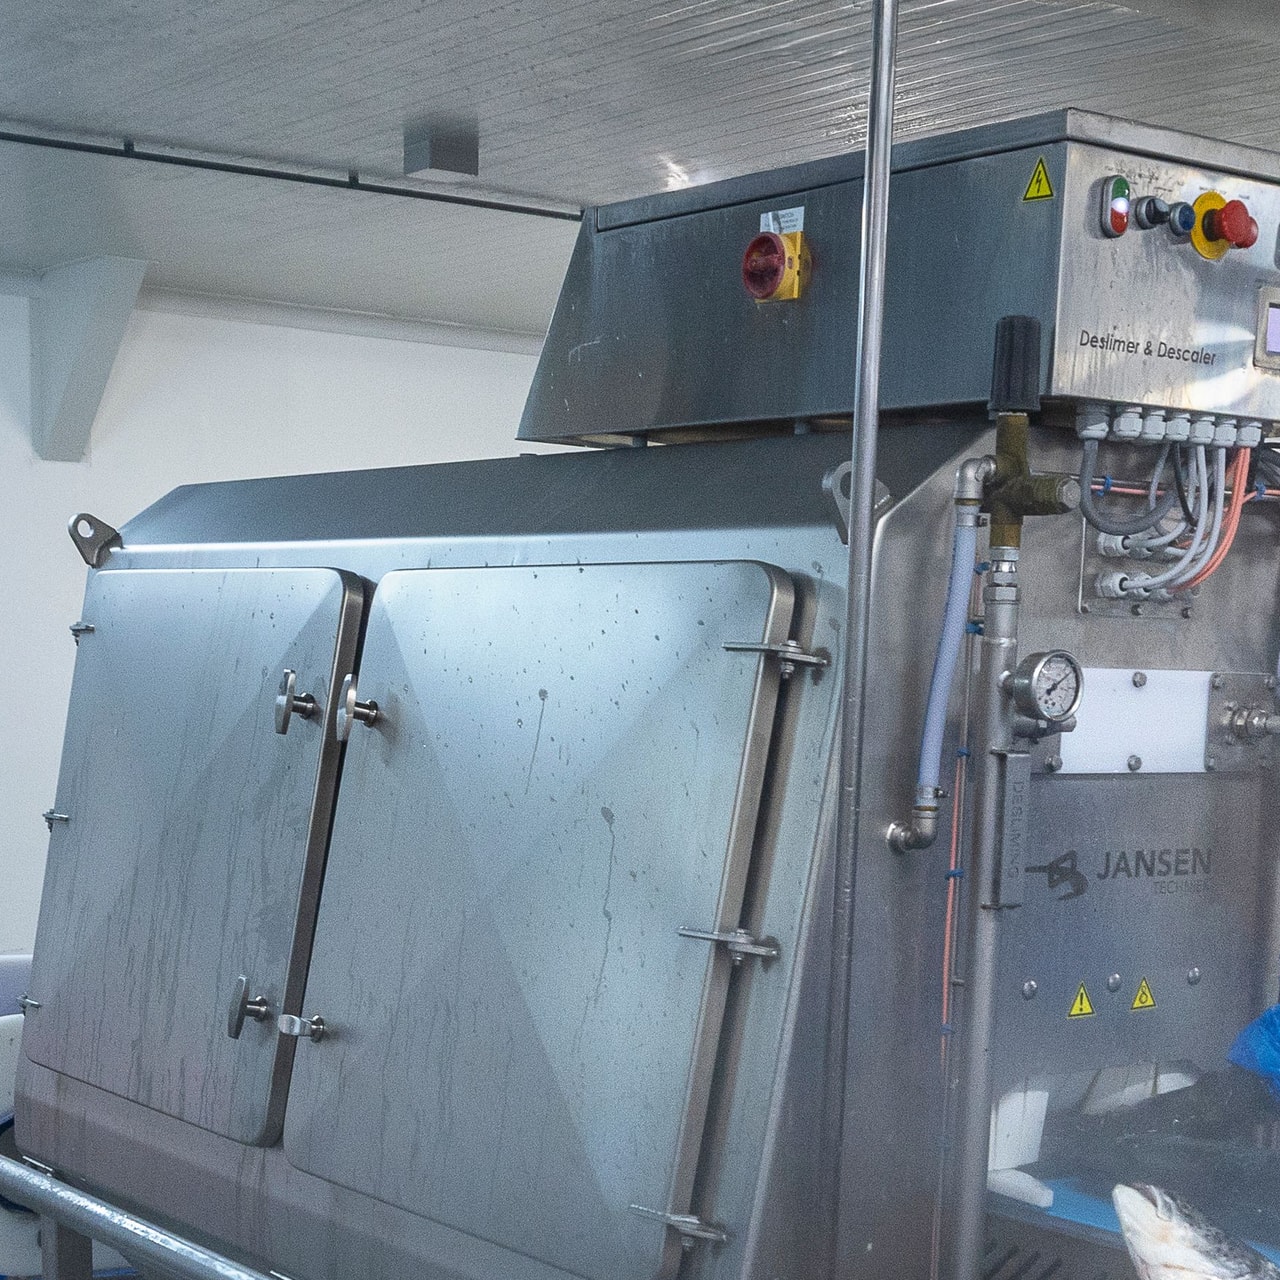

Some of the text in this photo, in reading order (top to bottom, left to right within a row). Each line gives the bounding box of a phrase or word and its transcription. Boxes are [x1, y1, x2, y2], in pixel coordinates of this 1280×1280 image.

[1079, 329, 1217, 366] Deslimer & Descaler
[1096, 847, 1212, 880] JANSEN
